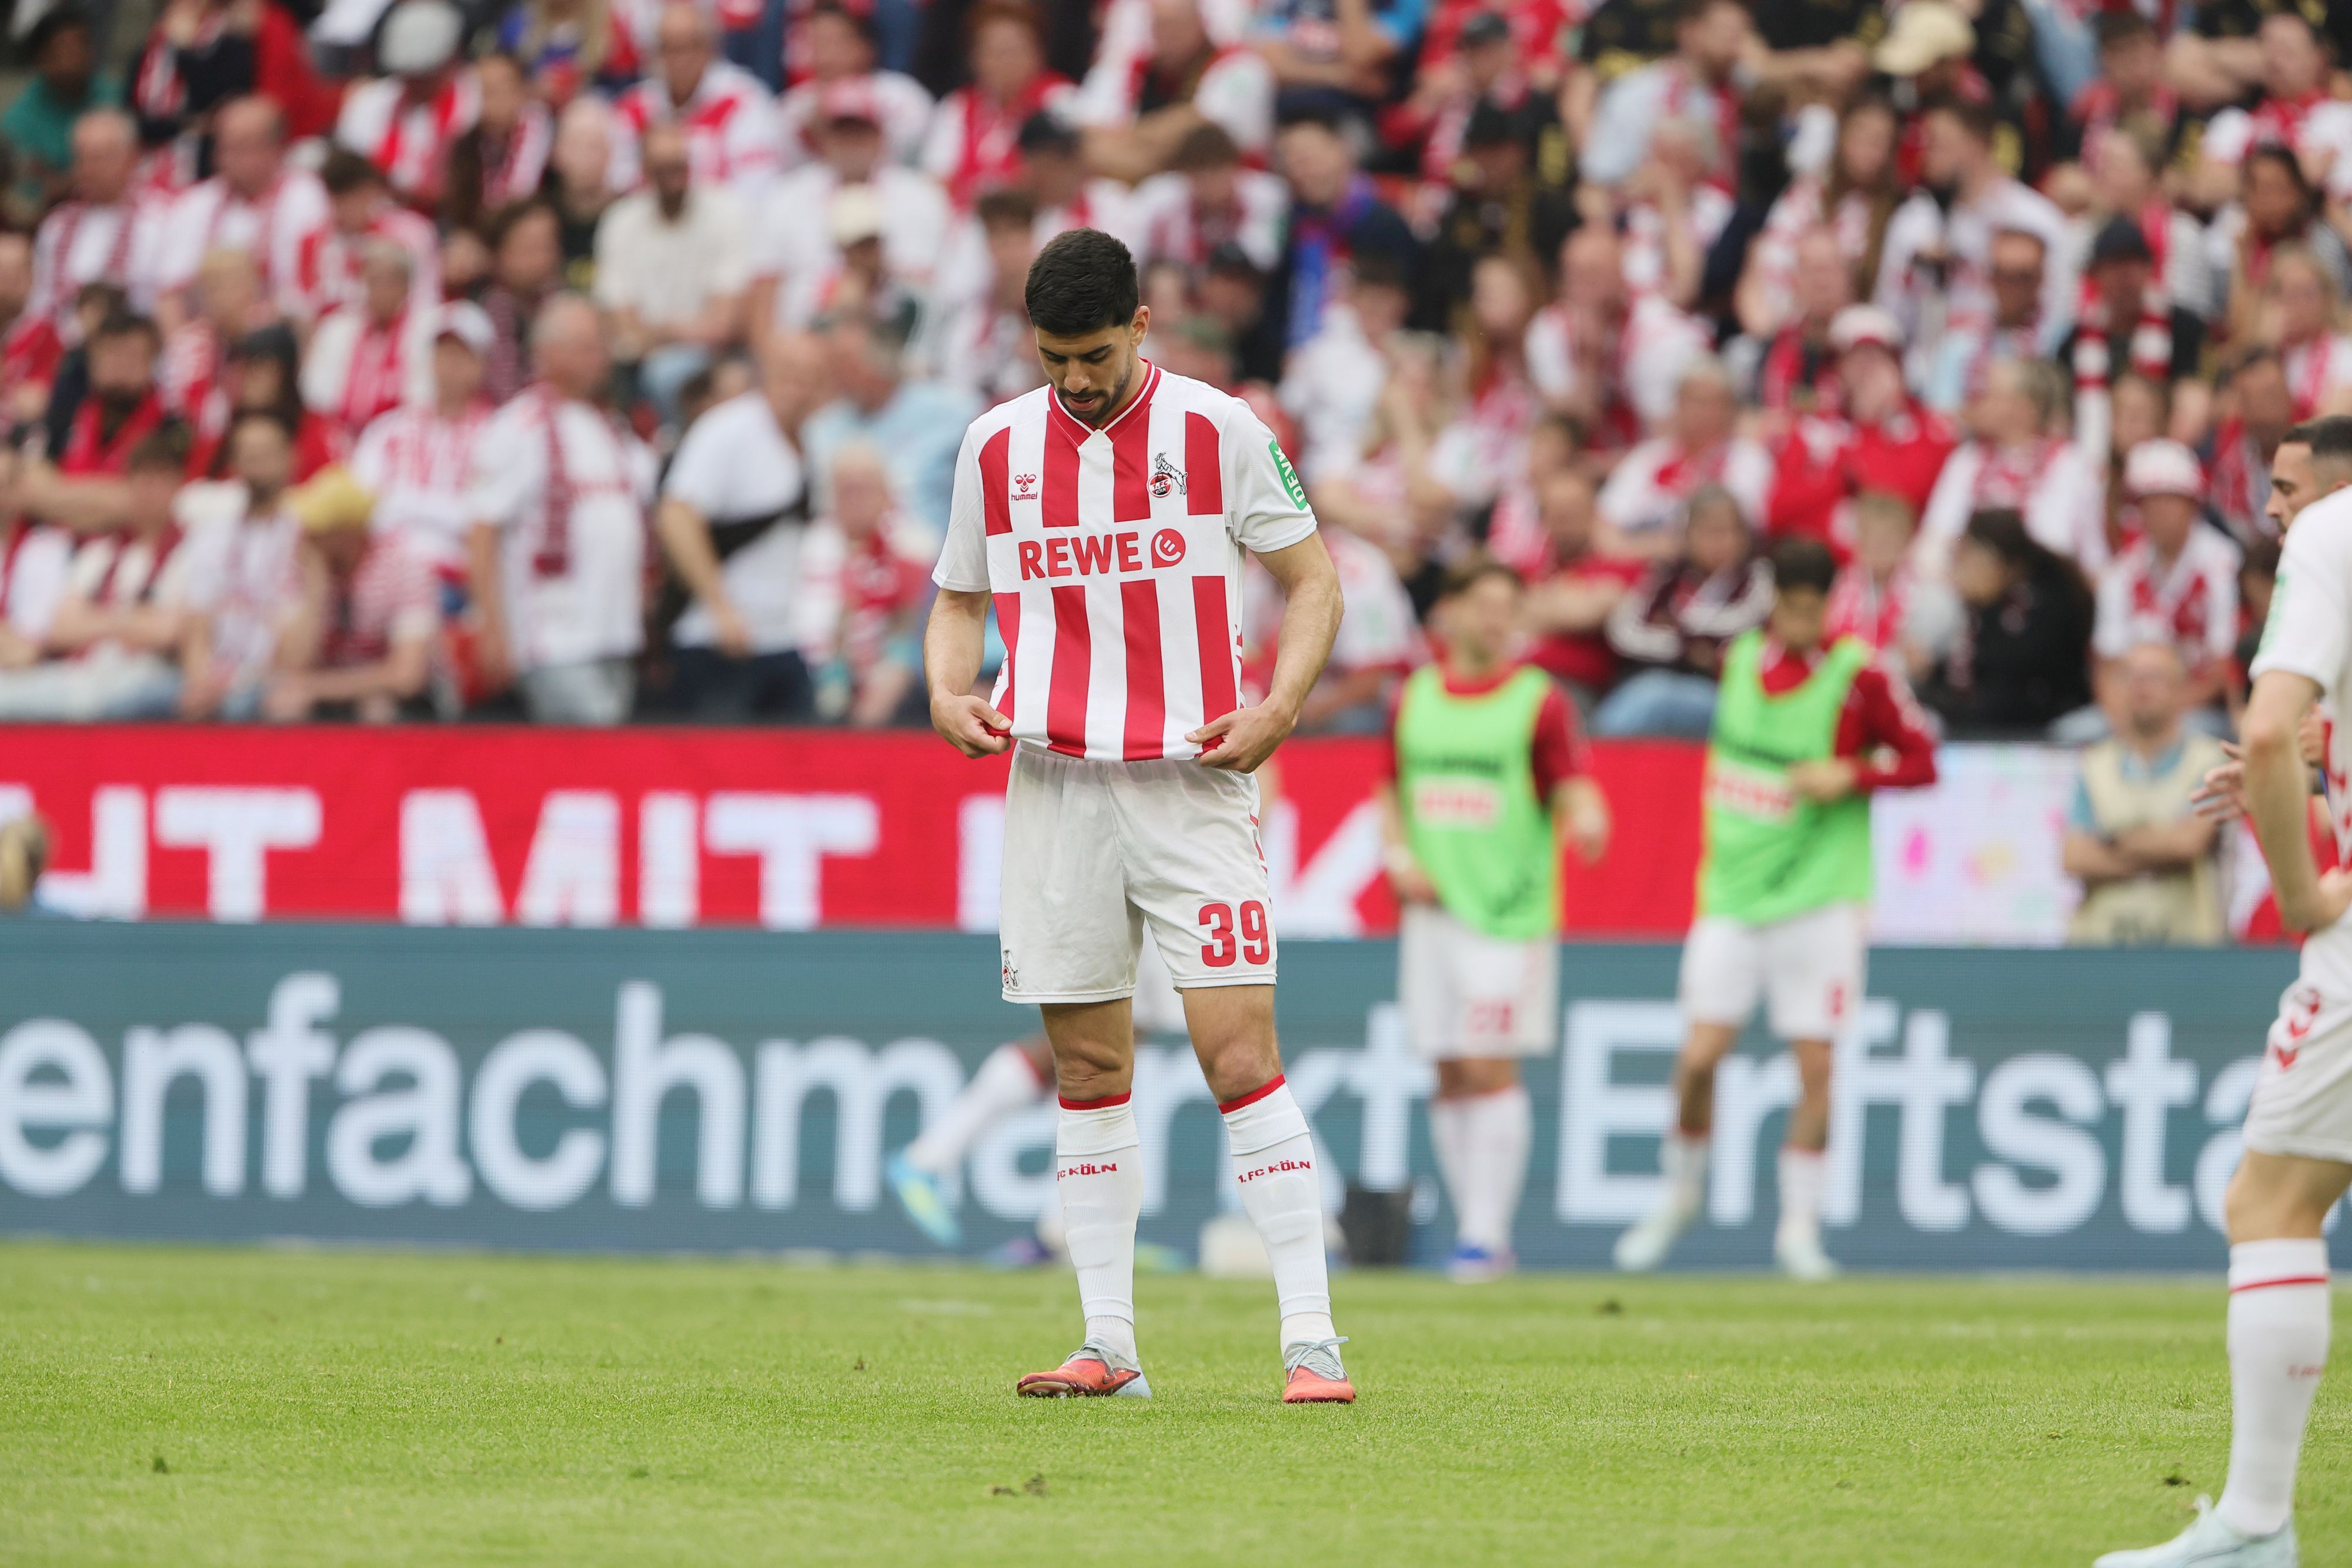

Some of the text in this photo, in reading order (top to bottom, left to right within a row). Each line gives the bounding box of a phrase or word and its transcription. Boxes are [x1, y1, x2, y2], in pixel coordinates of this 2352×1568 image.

[1011, 492, 1038, 501] hummel
[1274, 446, 1305, 503] DEVK
[1018, 532, 1142, 581] REWE
[397, 787, 880, 931] MIT
[1198, 900, 1270, 967] 39
[1068, 1163, 1117, 1176] KÖLN
[1268, 1159, 1311, 1174] KÖLN
